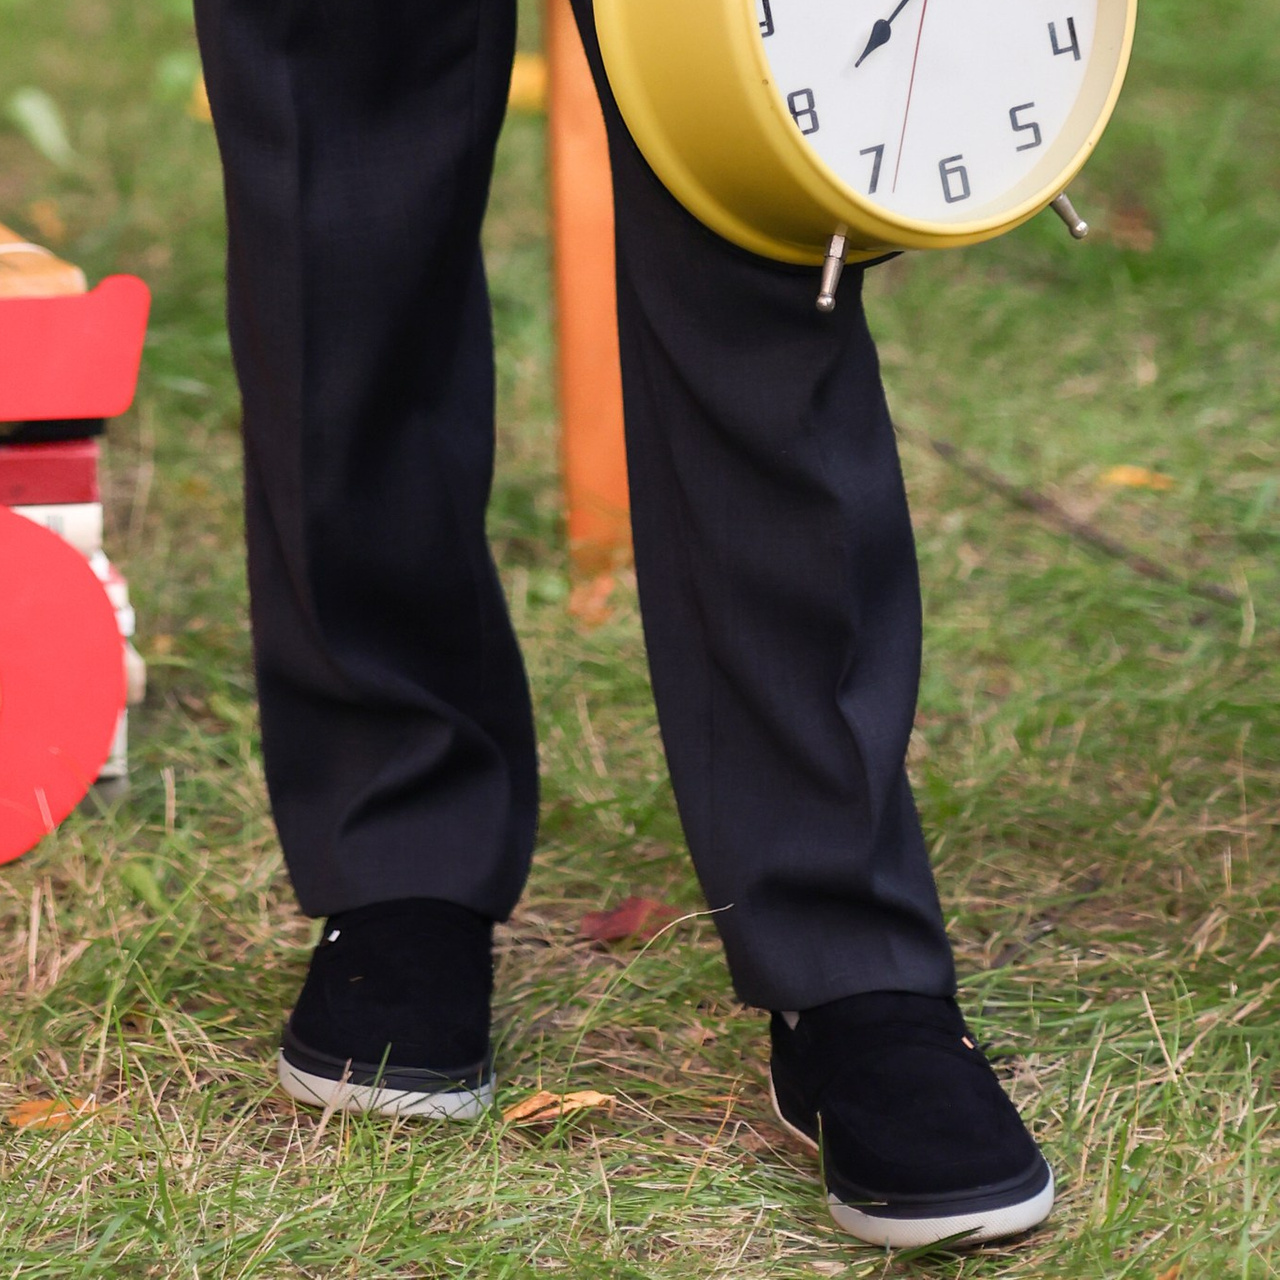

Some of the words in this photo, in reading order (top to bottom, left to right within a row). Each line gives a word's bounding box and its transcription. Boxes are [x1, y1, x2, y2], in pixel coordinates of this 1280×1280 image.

[1047, 16, 1083, 62] 4
[786, 88, 821, 136] 8
[1008, 101, 1043, 153] 5
[858, 143, 887, 195] 7
[937, 154, 972, 204] 6
